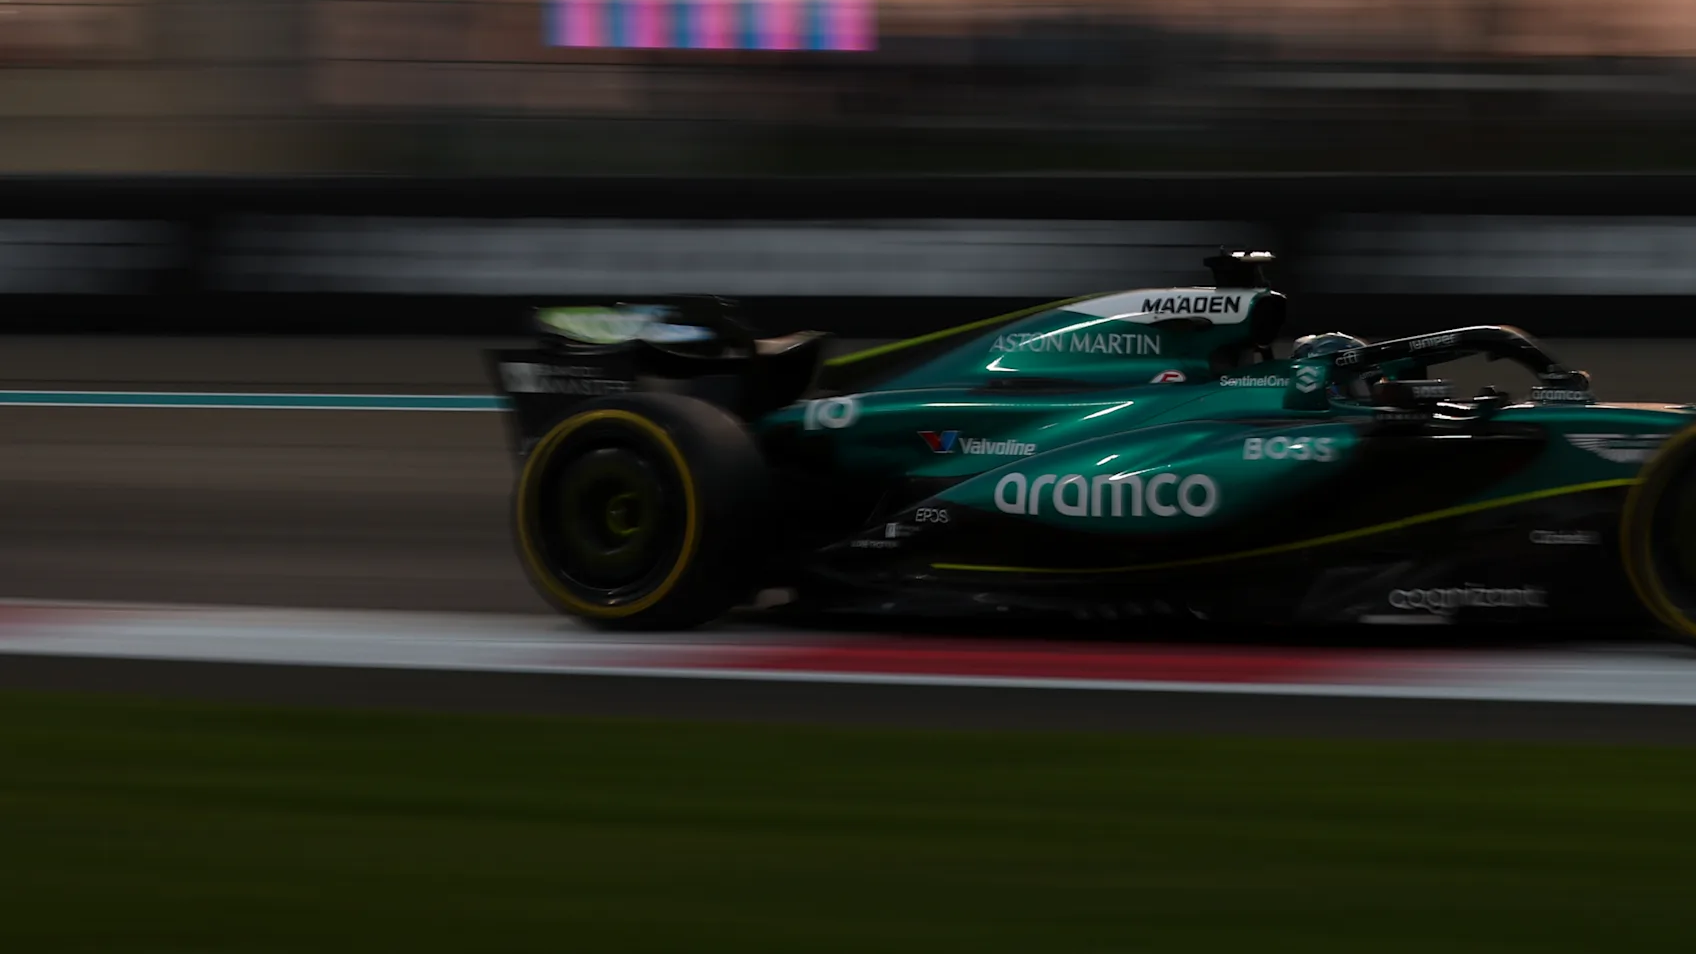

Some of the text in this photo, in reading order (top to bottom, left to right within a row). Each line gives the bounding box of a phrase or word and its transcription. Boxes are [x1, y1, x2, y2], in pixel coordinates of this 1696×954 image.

[988, 332, 1161, 355] ASTON MARTIN
[1532, 390, 1584, 401] aramco
[959, 438, 1037, 456] Valvoline
[1242, 436, 1340, 462] BOSS
[994, 472, 1220, 517] aramco
